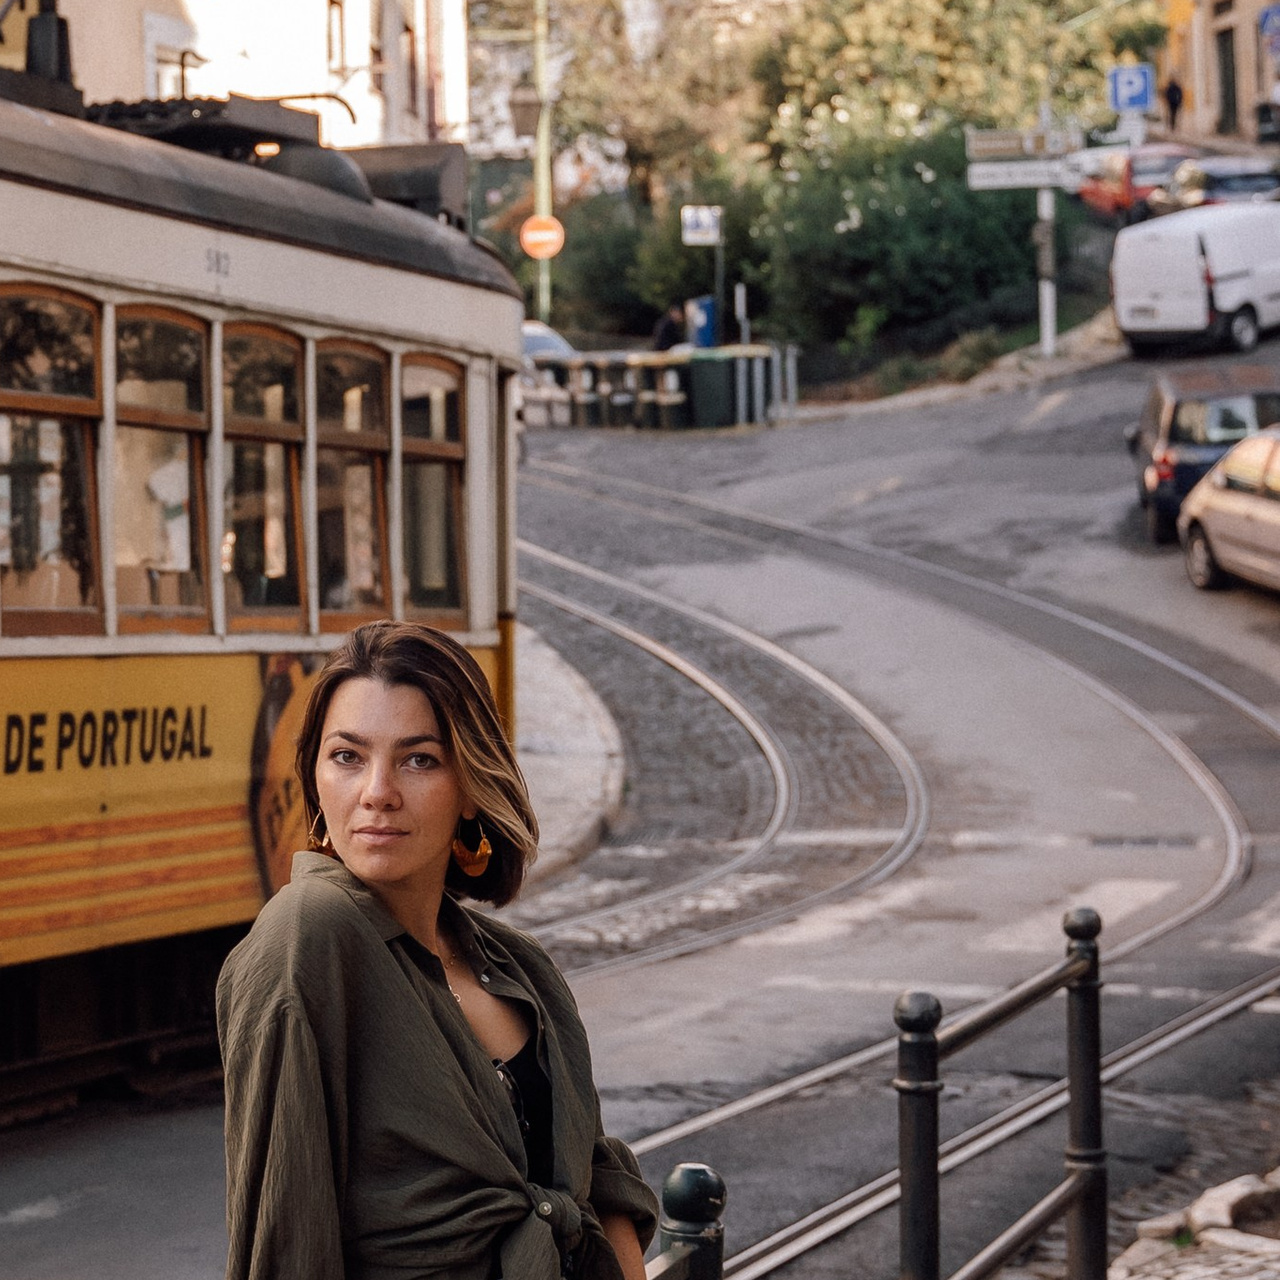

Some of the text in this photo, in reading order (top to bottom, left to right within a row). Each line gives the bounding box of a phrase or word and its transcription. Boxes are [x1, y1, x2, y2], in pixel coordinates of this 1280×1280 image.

[1118, 70, 1144, 107] P
[3, 712, 48, 775] DE
[56, 705, 213, 770] PORTUGAL
